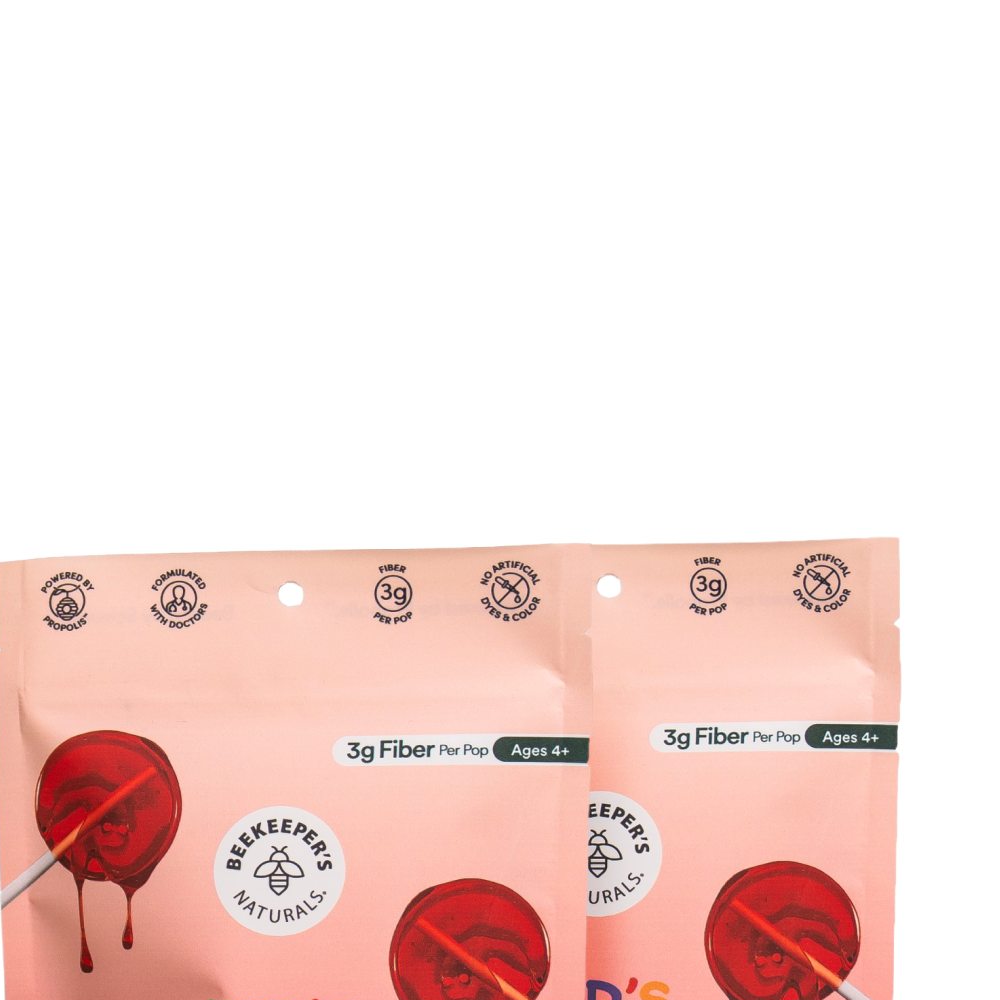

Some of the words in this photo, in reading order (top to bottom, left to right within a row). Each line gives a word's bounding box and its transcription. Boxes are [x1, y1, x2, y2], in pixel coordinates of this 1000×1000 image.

[378, 564, 407, 574] FIBER
[480, 571, 493, 586] NO
[492, 560, 541, 586] ARTIFICIAL
[693, 556, 722, 567] FIBER
[792, 563, 805, 578] NO
[804, 553, 851, 578] ARTIFICIAL
[41, 571, 84, 593] POWERED
[82, 579, 95, 591] BY
[151, 568, 206, 592] FORMULATED
[696, 575, 722, 597] 3g
[380, 583, 407, 606] 3g
[792, 589, 813, 611] DYES
[823, 588, 851, 613] COLOR
[150, 603, 168, 626] WITH
[168, 603, 208, 629] DOCTORS
[373, 611, 391, 625] PER
[393, 611, 413, 625] POP
[480, 597, 502, 619] DYES
[512, 596, 541, 622] COLOR
[689, 603, 707, 616] PER
[709, 602, 727, 616] POP
[663, 728, 691, 749] 3g
[695, 726, 749, 746] Fiber
[752, 730, 773, 743] Per
[776, 730, 801, 746] Pop
[822, 730, 858, 746] Ages
[861, 730, 879, 744] 4+
[346, 742, 375, 763] 3g
[379, 739, 435, 759] Fiber
[439, 744, 461, 757] Per
[463, 743, 489, 760] Pop
[511, 743, 548, 759] Ages
[551, 743, 570, 757] 4+
[588, 803, 650, 854] EEPER'S
[225, 818, 333, 871] BEEKEEPER'S
